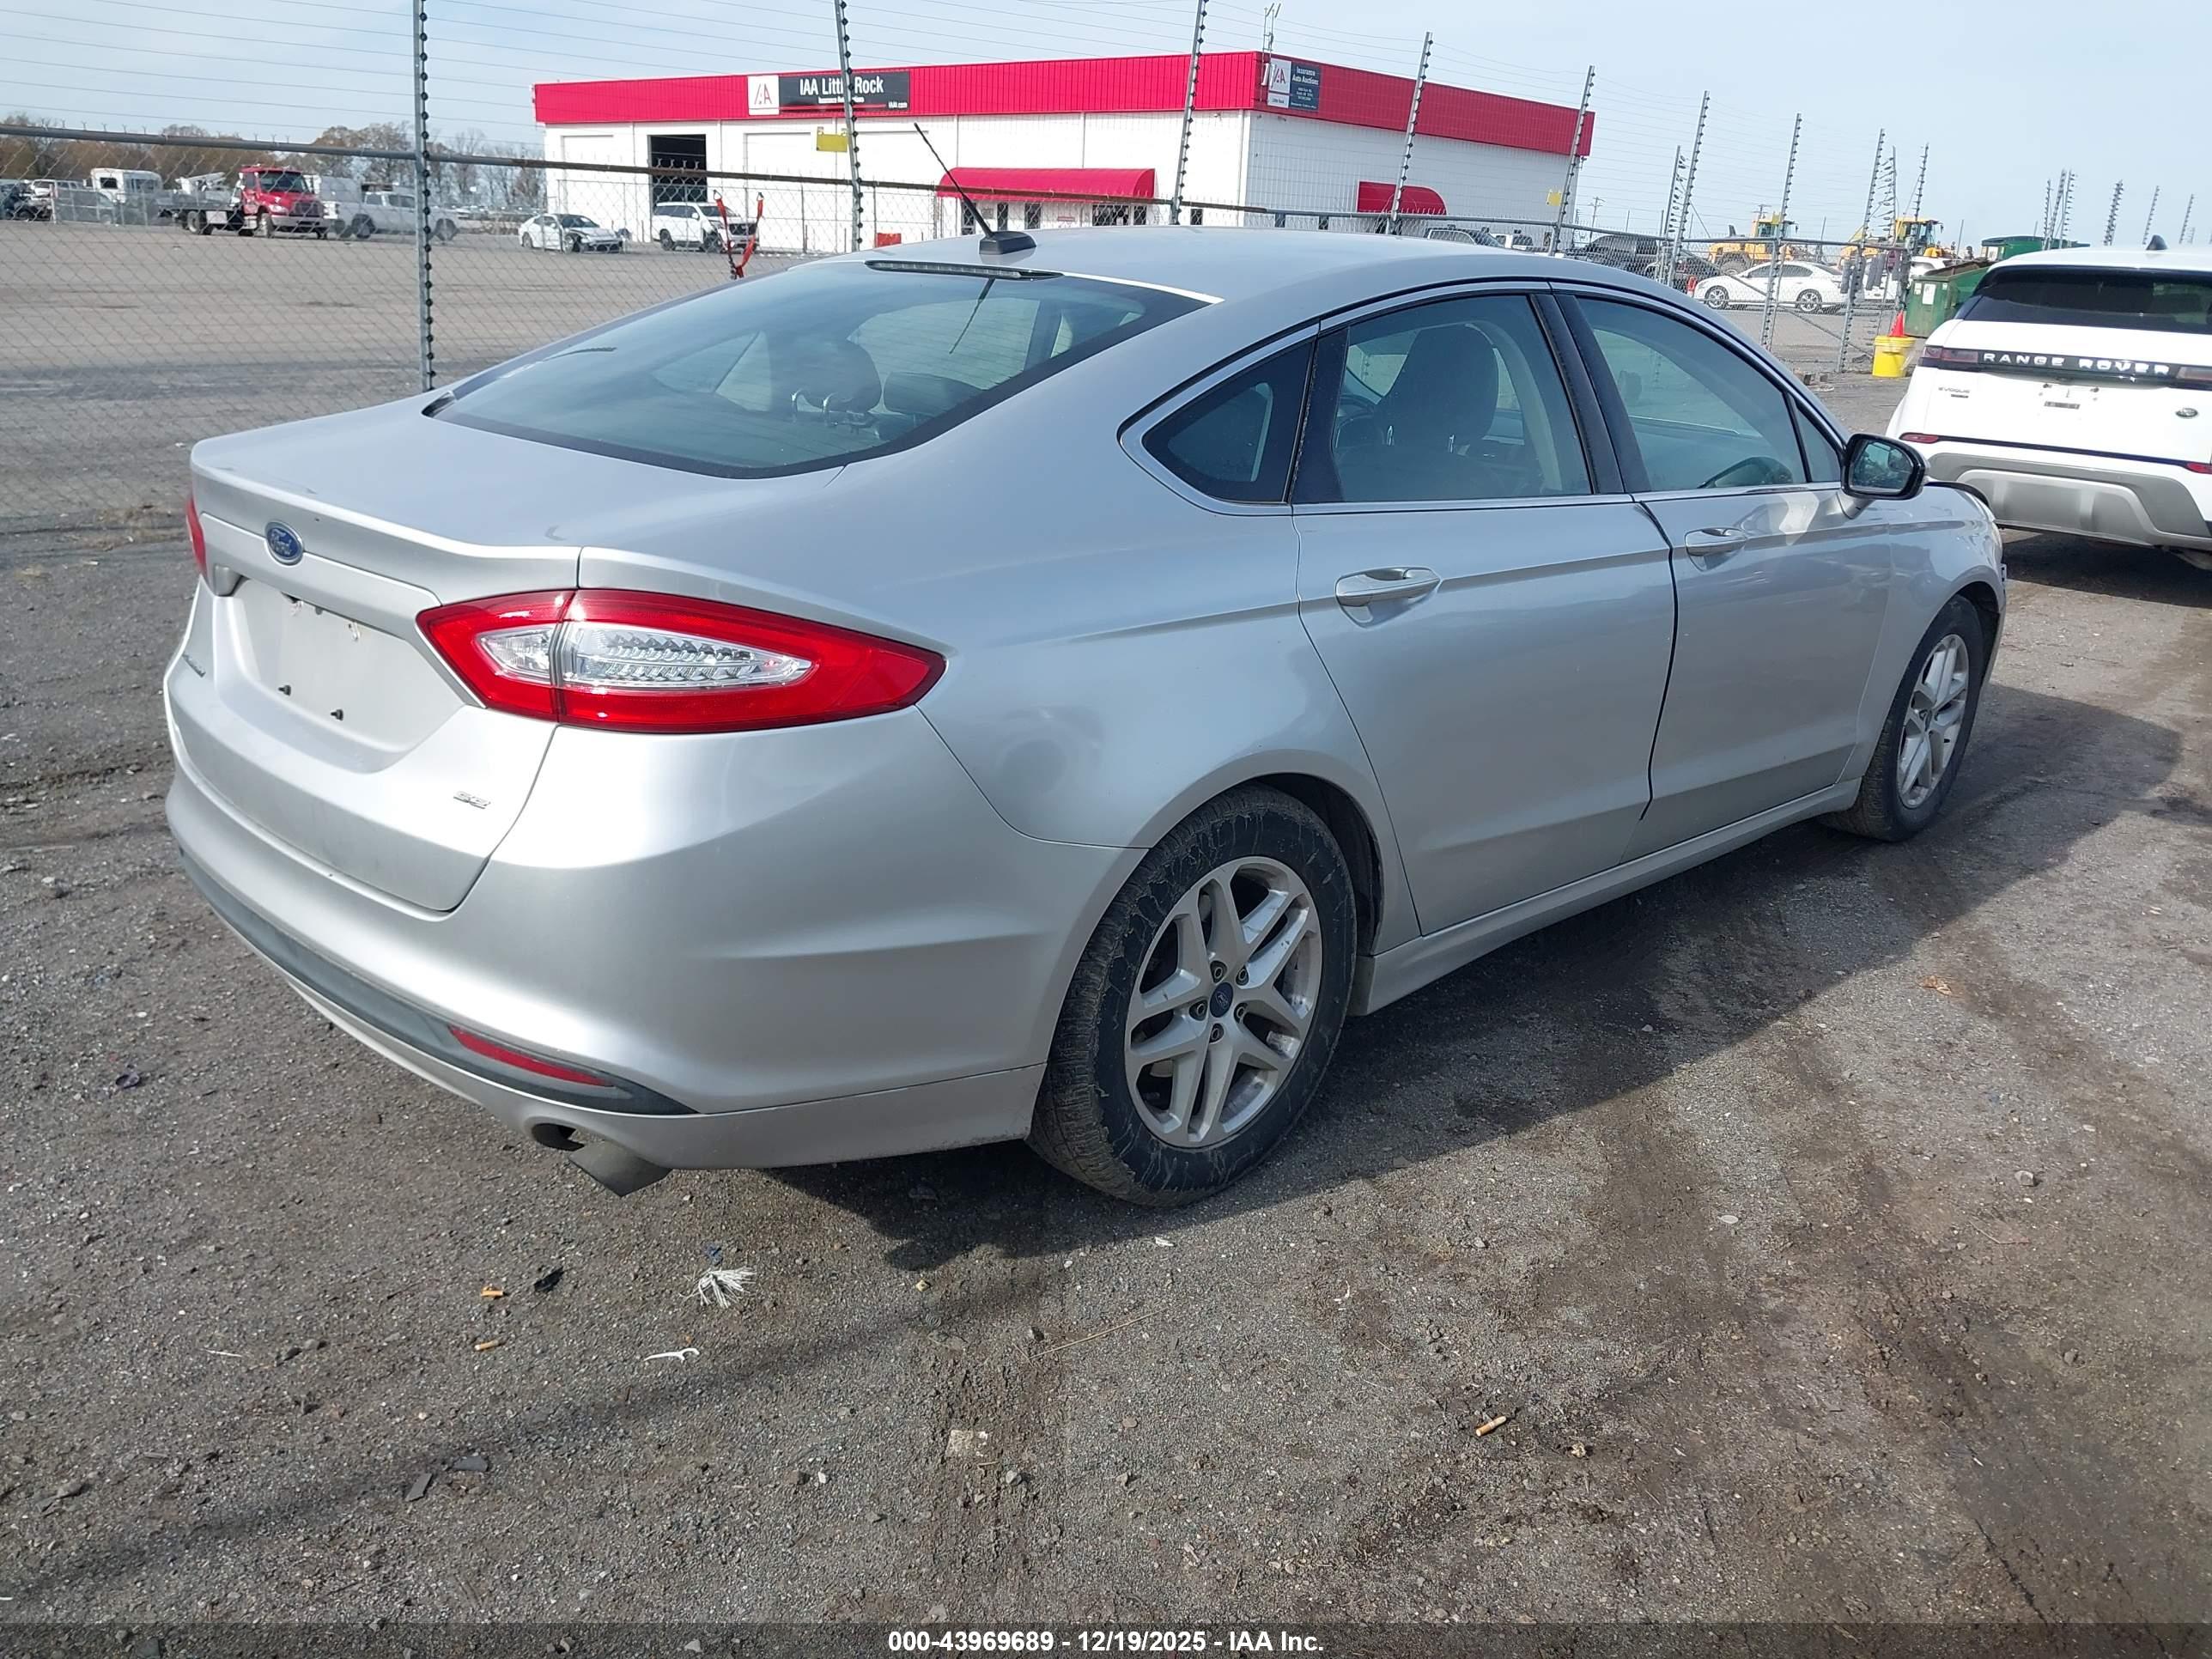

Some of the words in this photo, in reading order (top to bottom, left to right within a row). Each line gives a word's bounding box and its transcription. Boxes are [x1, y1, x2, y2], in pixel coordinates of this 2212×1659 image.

[799, 78, 818, 95] IAA
[822, 77, 845, 94] Littl
[854, 76, 884, 94] Rock
[1984, 352, 2065, 367] RANGE
[2079, 359, 2170, 376] ROVER
